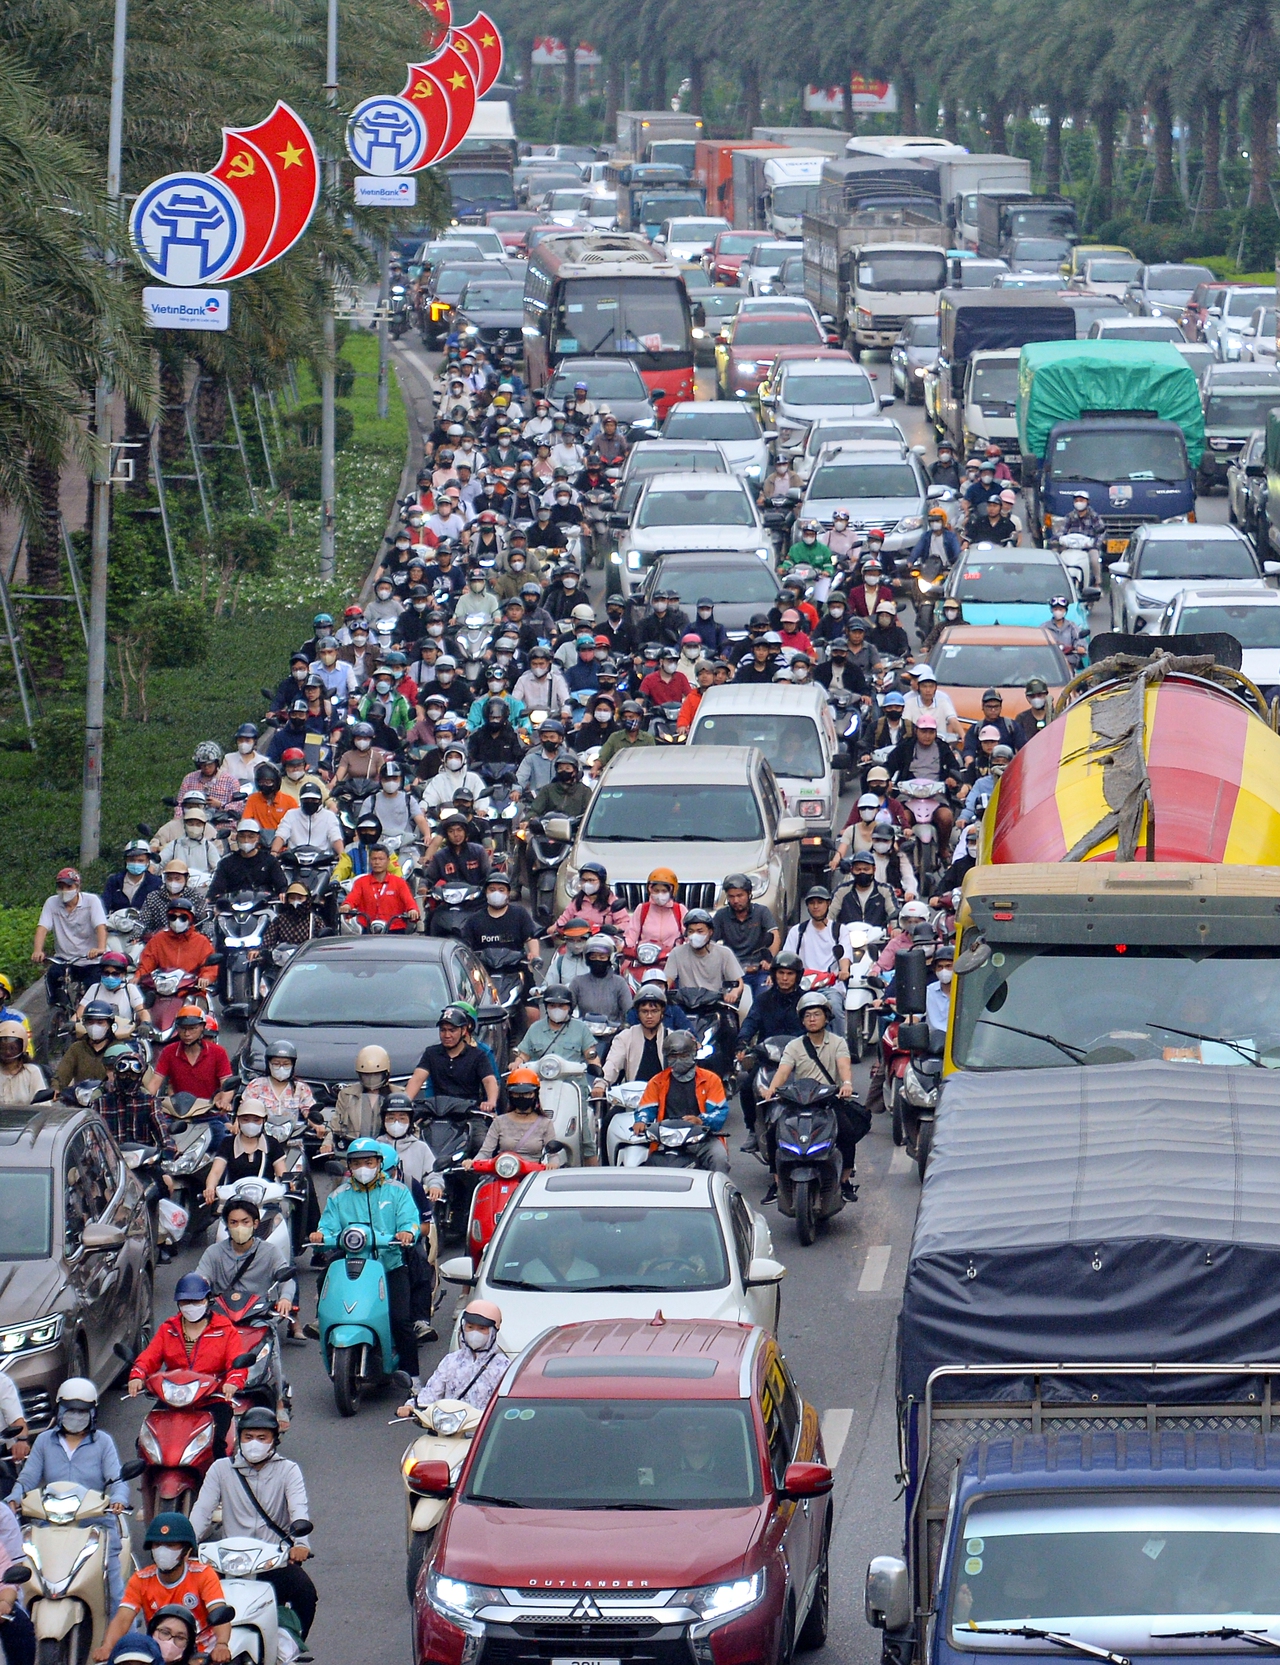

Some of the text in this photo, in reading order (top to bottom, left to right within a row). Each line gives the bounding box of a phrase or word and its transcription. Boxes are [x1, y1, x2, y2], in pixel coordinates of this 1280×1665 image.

[360, 188, 399, 196] VietinBank
[151, 303, 206, 315] VietinBank
[529, 1579, 649, 1587] OUTLANDER
